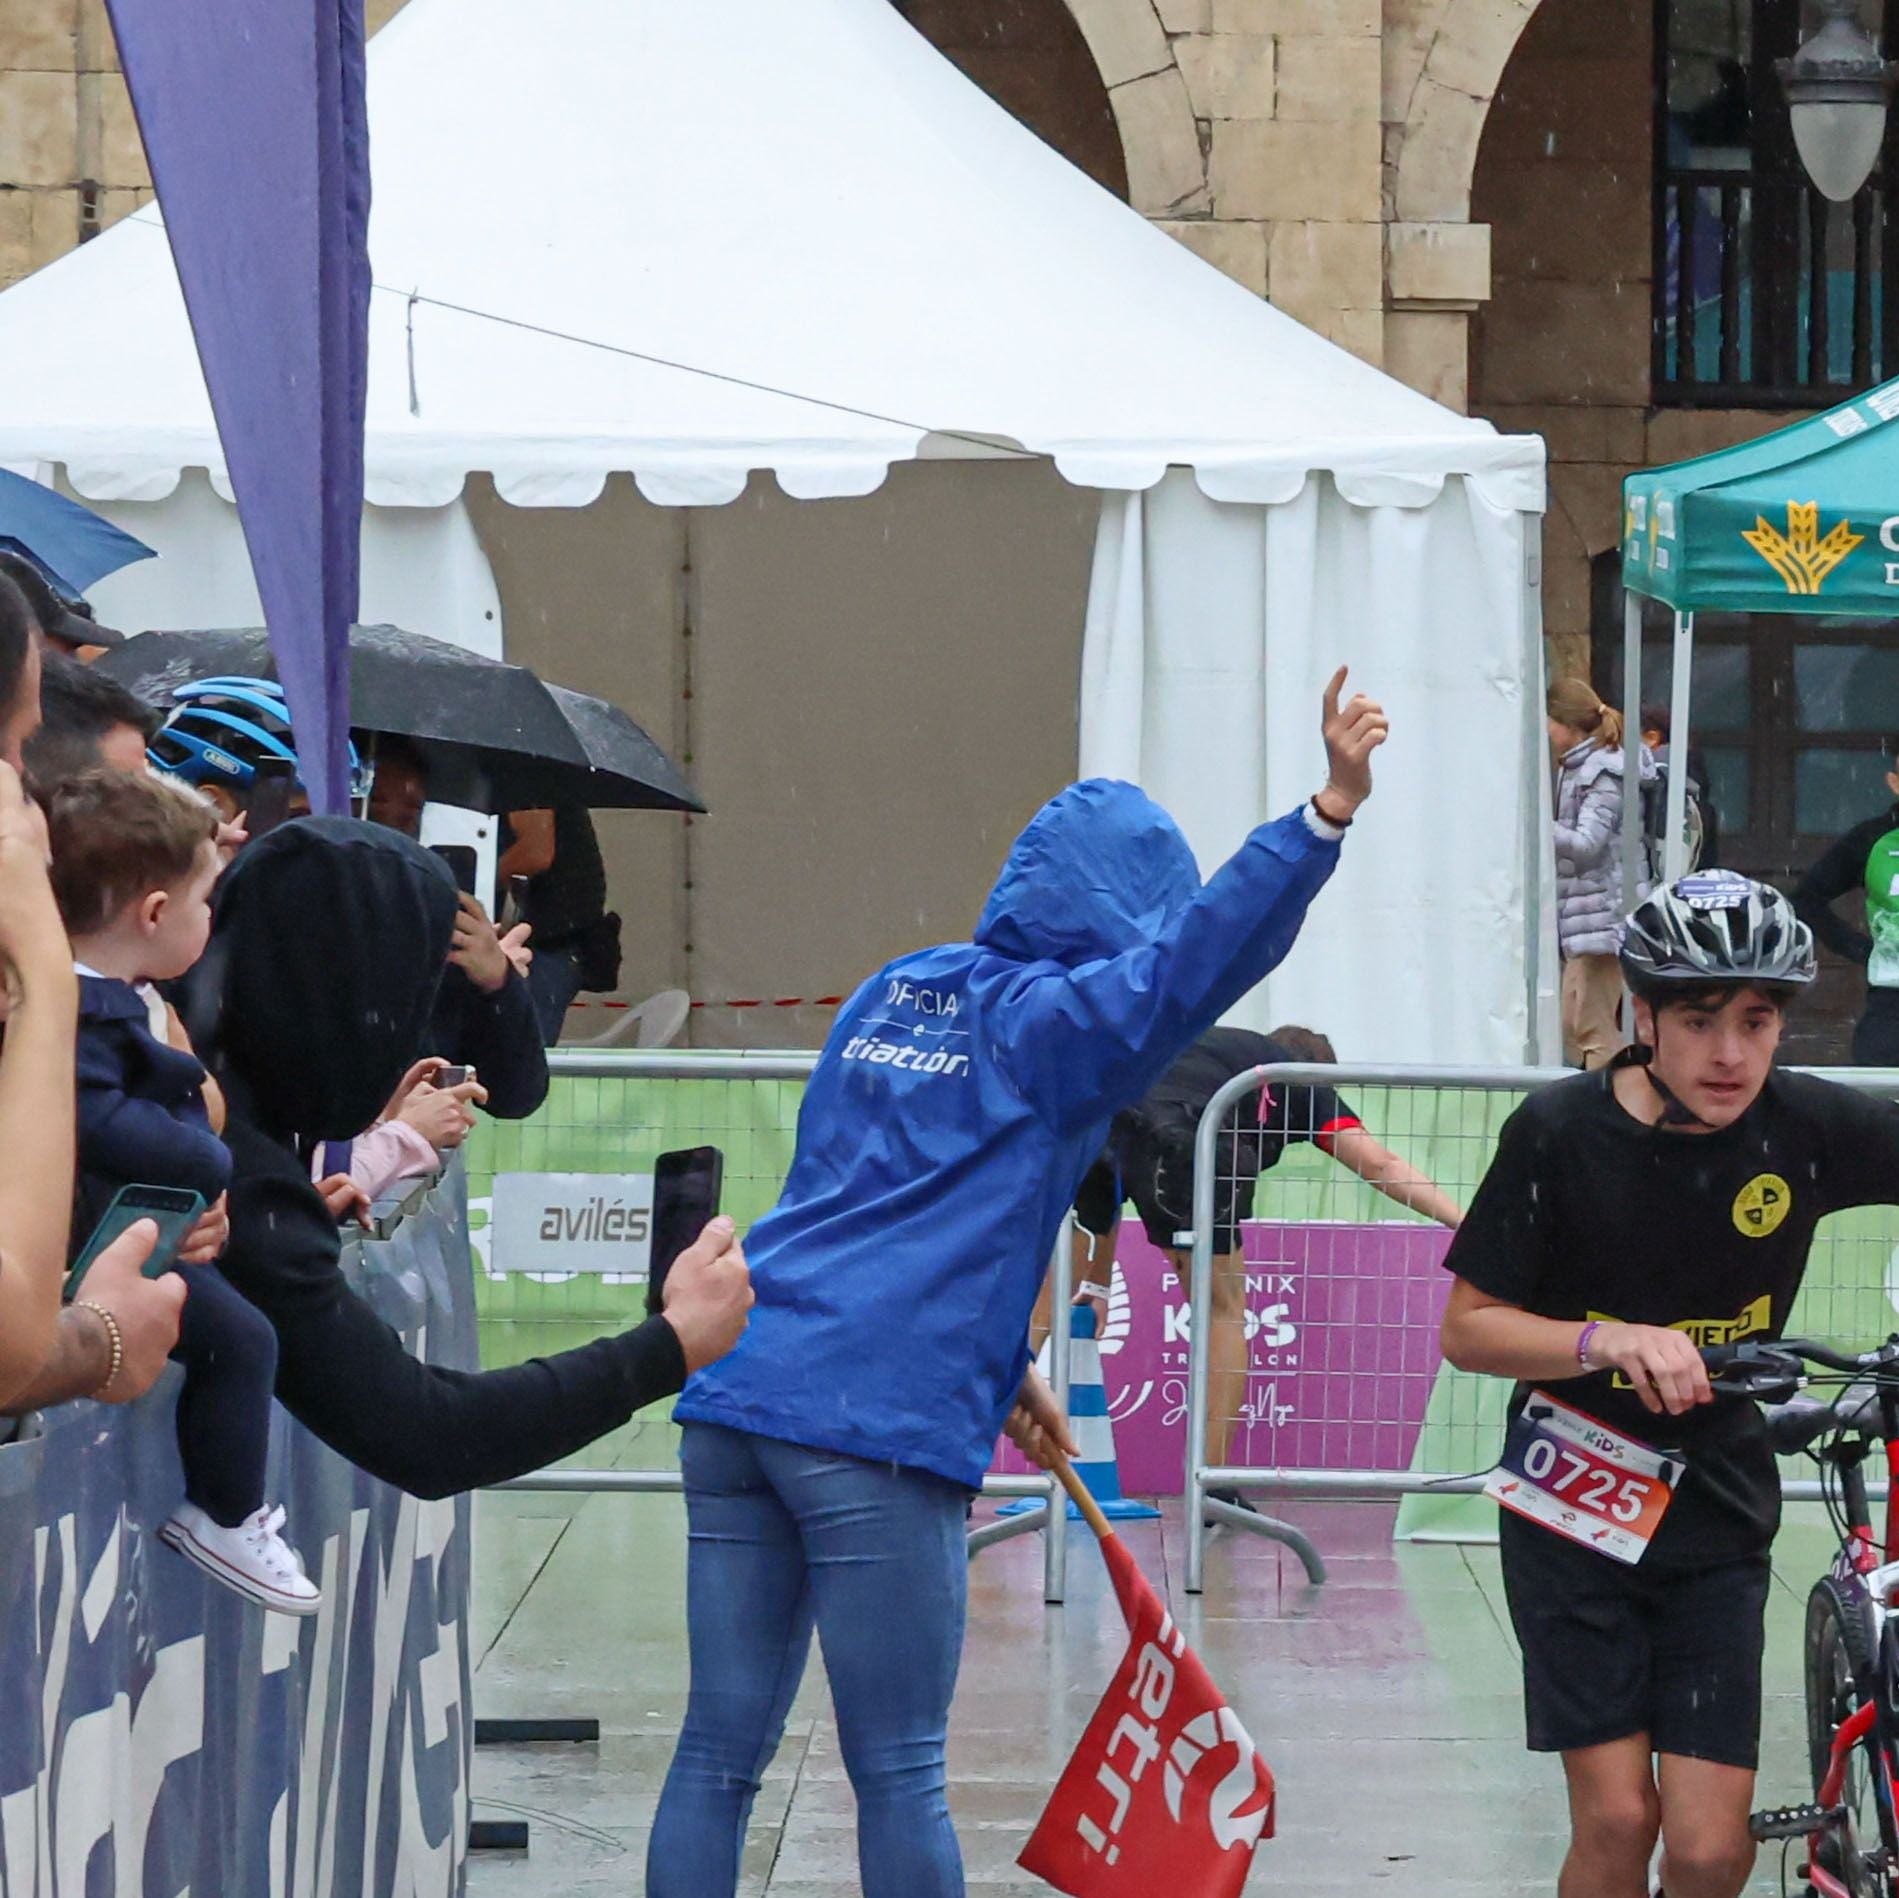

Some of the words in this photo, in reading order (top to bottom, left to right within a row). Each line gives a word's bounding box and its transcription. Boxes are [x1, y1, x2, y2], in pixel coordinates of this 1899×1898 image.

[539, 1197, 650, 1242] avilés
[1162, 1273, 1296, 1294] PNIX
[1162, 1352, 1298, 1366] TRLON
[1523, 1438, 1650, 1523] 0725
